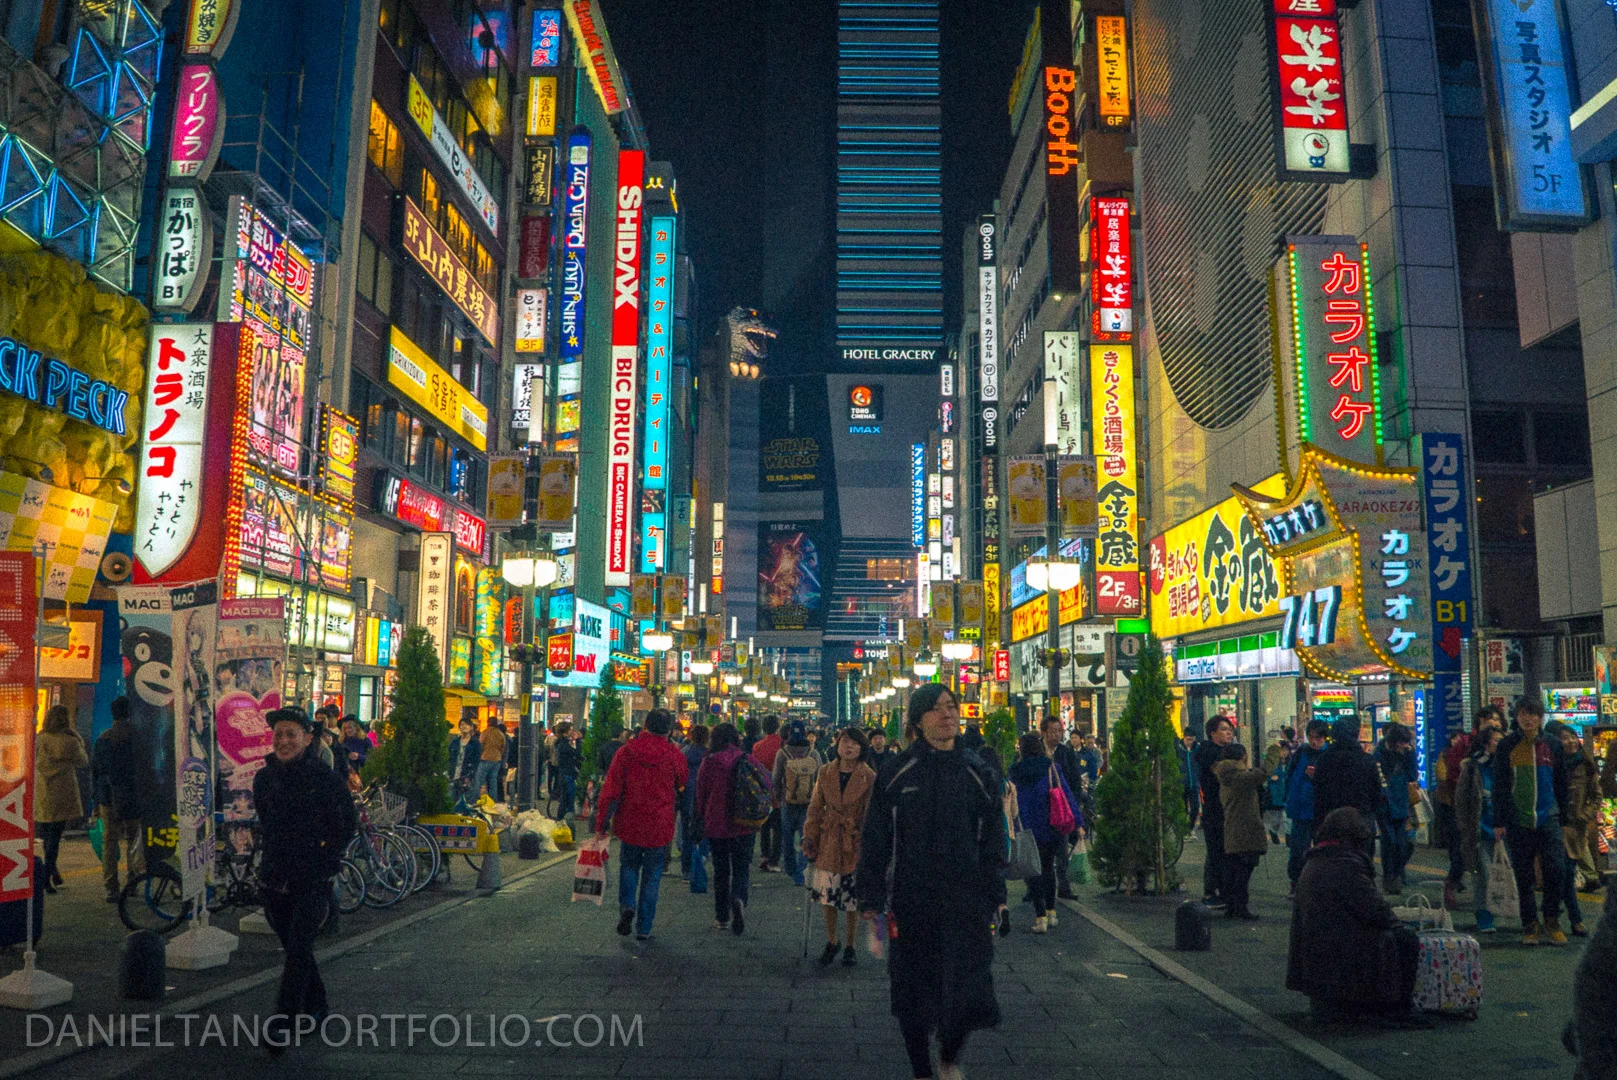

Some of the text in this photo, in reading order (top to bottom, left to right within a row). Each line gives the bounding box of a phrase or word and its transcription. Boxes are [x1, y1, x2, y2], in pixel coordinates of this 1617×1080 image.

[532, 19, 560, 67] 海の家
[1281, 23, 1341, 126] 笑笑
[1516, 20, 1553, 154] 写真スタジオ
[1045, 66, 1078, 175] Booth
[1107, 116, 1124, 126] 6F
[179, 162, 198, 174] 1F
[1532, 164, 1563, 195] 5F
[163, 210, 193, 277] かっぱ
[615, 186, 642, 310] SHIDAX
[980, 223, 995, 261] Booth
[162, 285, 184, 299] B1
[418, 228, 487, 331] 山内農場
[983, 271, 993, 315] ネットカフェ
[184, 328, 210, 410] 大衆酒場
[523, 340, 537, 350] 3F
[843, 349, 936, 360] HOTEL GRACERY
[1321, 252, 1373, 439] カラオケ
[47, 358, 129, 436] PECK
[147, 337, 187, 478] トラノコ
[612, 358, 632, 457] BIC DRUG
[1103, 351, 1124, 454] きんくら酒場
[332, 434, 350, 458] 3F
[849, 426, 881, 434] IMAX
[983, 407, 998, 447] Booth
[614, 466, 625, 482] BIC
[143, 491, 173, 552] やきとん
[165, 478, 194, 540] やきとり
[1097, 480, 1138, 567] 金の蔵
[1262, 501, 1319, 545] カラオケ
[1429, 442, 1466, 591] カラオケ
[985, 544, 998, 553] 4F
[985, 553, 998, 561] 3F
[1167, 542, 1199, 581] きんくら
[1098, 575, 1126, 597] 2F
[1381, 529, 1417, 654] カラオケ
[1279, 585, 1338, 651] 747
[1436, 599, 1467, 622] B1
